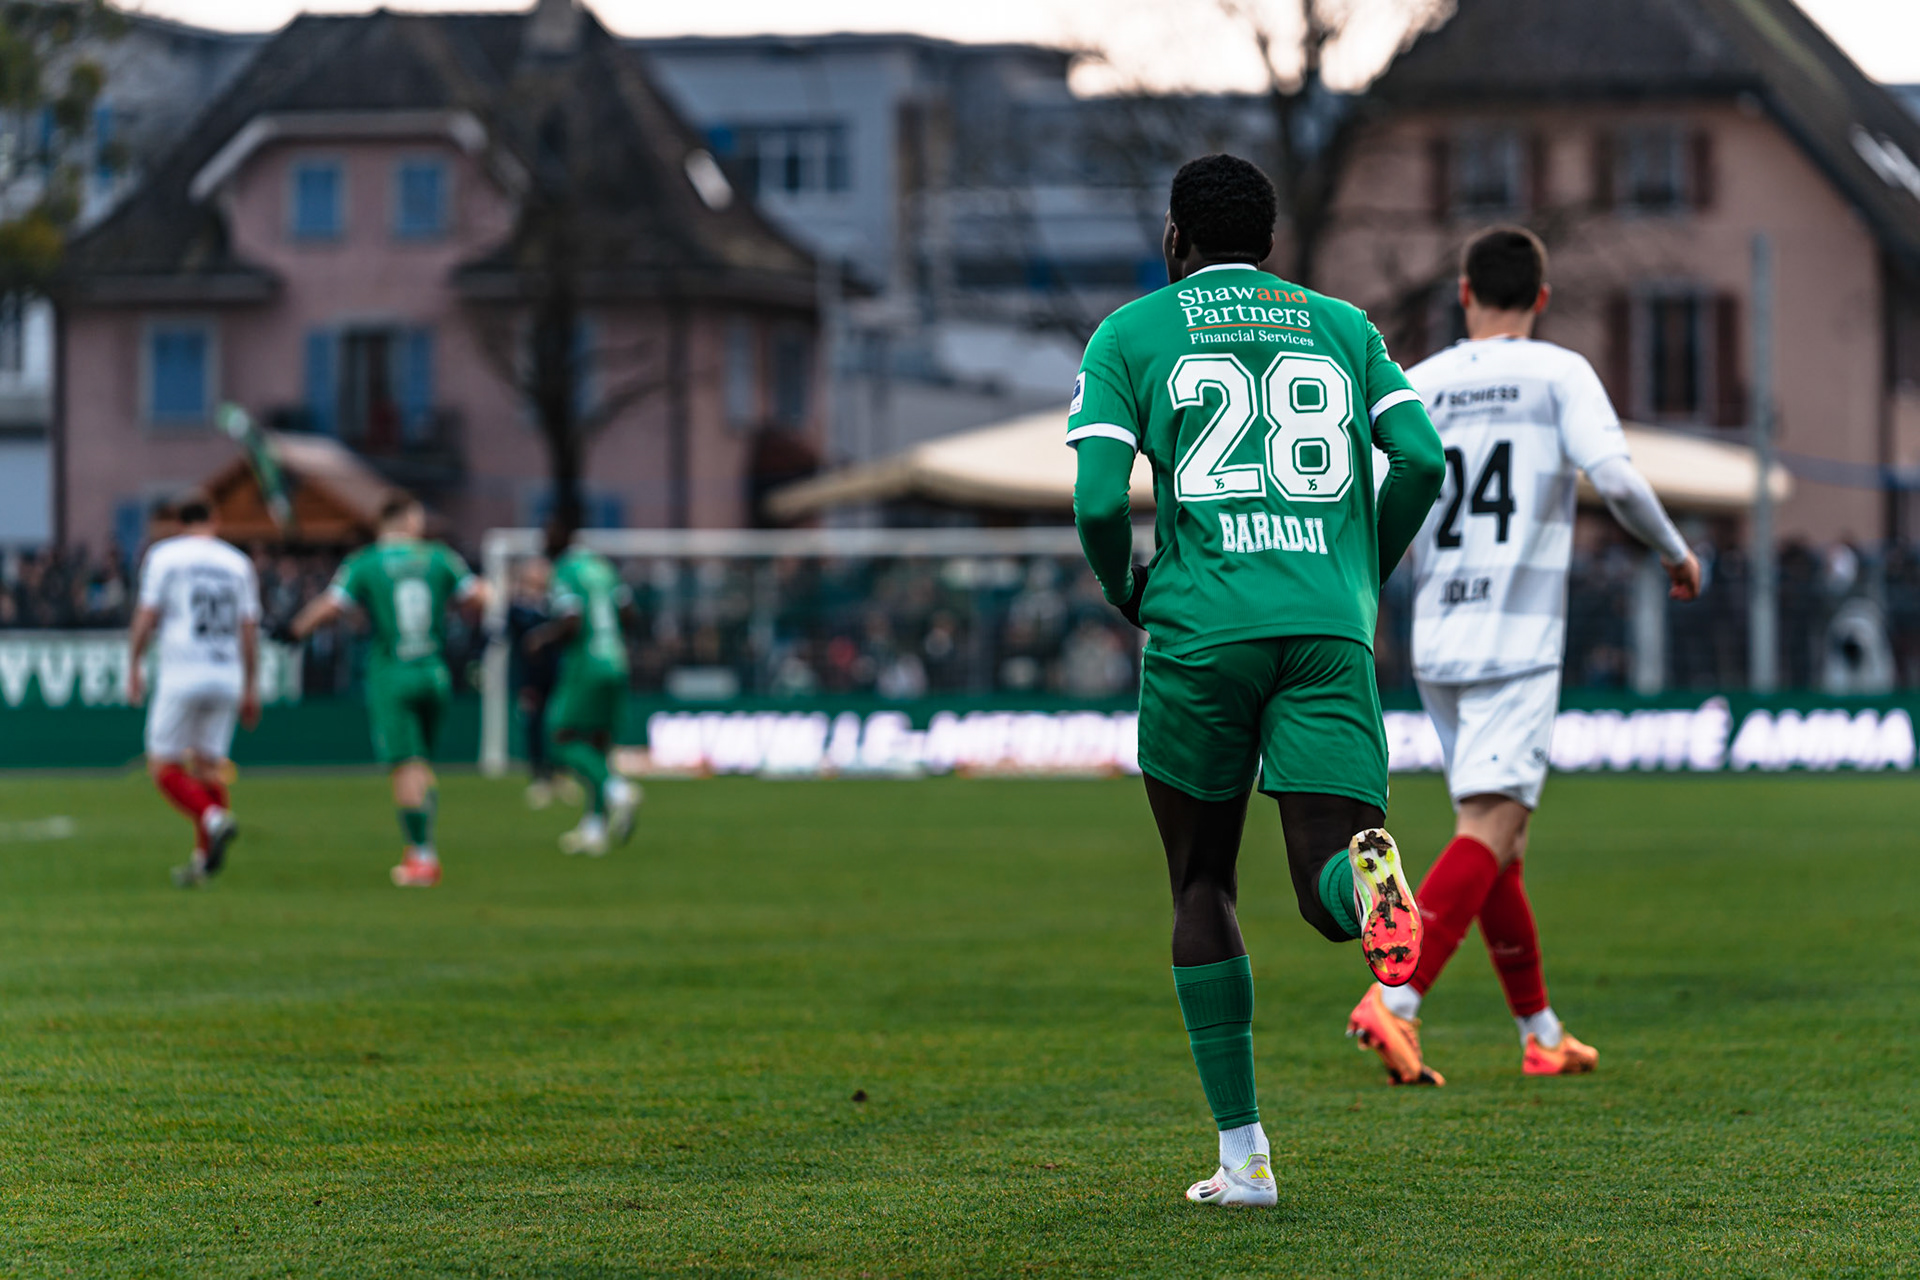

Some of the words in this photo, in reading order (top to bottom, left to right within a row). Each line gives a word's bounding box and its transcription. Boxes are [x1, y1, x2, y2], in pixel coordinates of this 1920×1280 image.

[1182, 303, 1311, 328] Partners
[1189, 329, 1255, 345] Financial
[1258, 330, 1315, 347] Services
[1167, 351, 1354, 502] 28
[1434, 439, 1516, 549] 24
[1218, 512, 1328, 554] BARADJI
